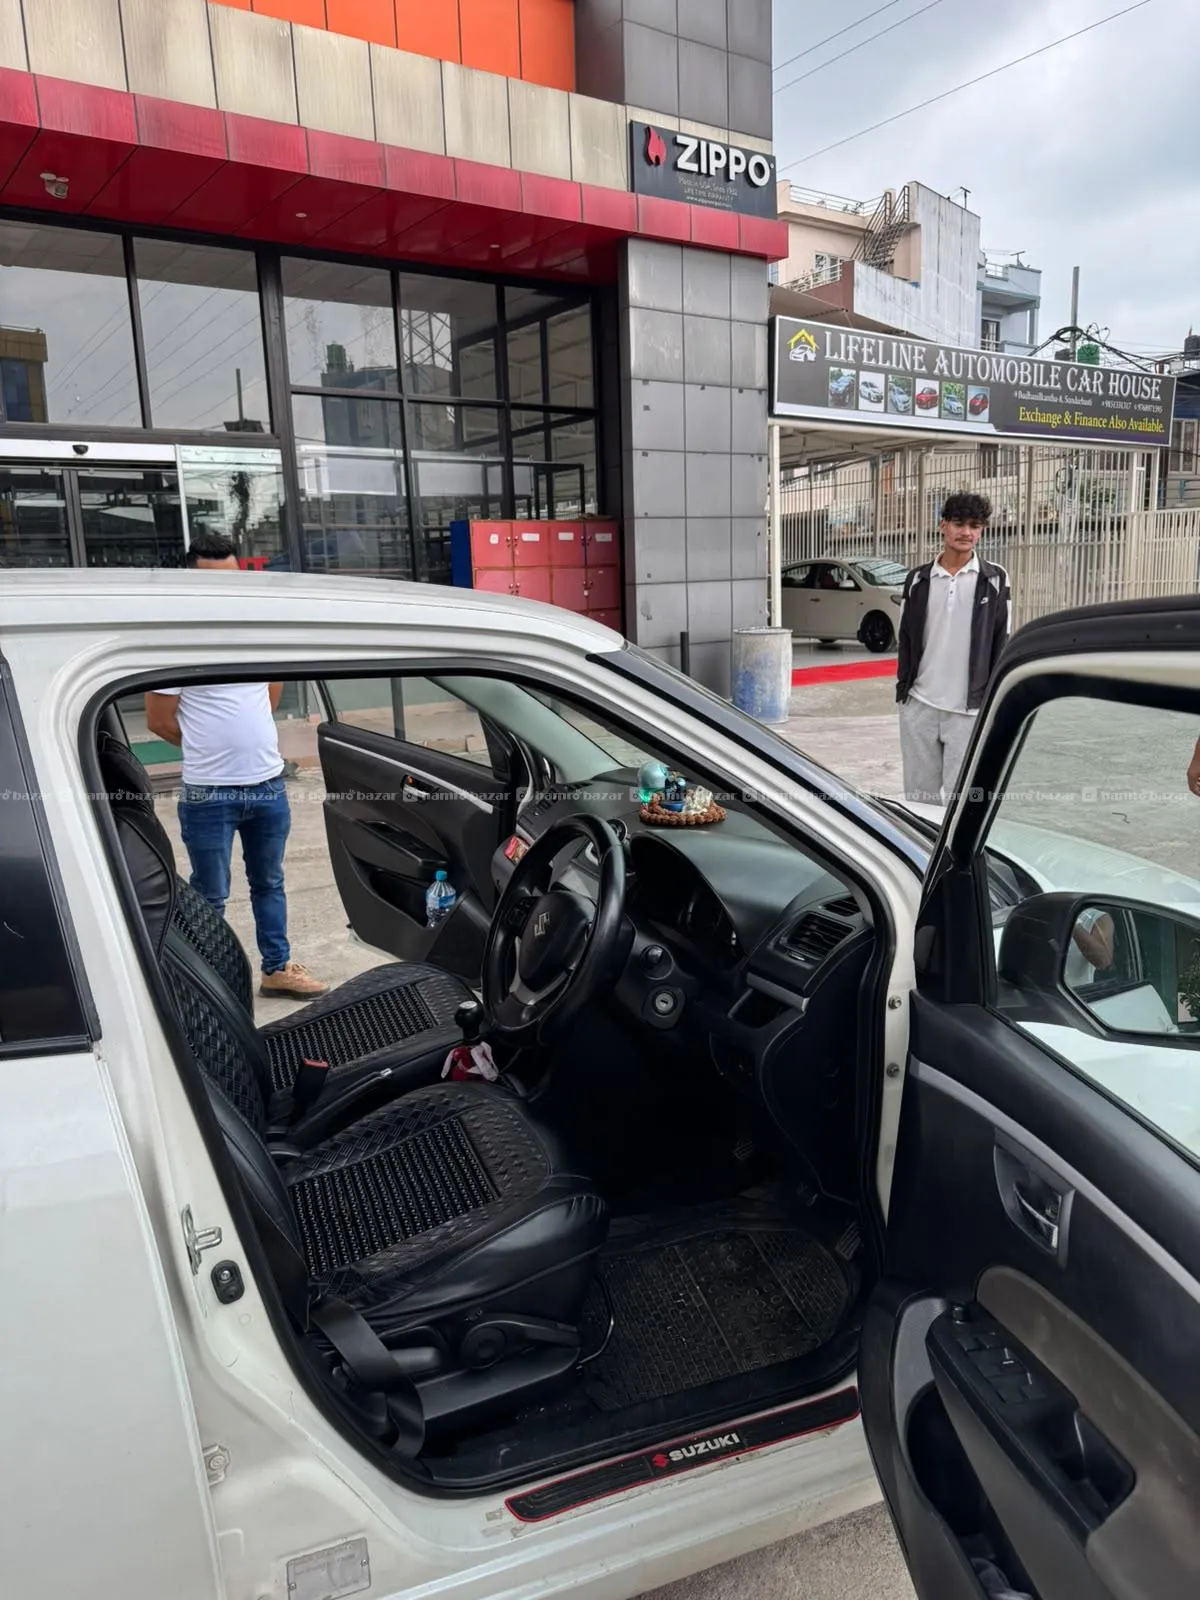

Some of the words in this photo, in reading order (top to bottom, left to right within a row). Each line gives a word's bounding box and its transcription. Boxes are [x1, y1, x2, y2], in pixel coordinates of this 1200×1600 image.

[675, 134, 771, 187] ZIPPO
[824, 331, 928, 374] LIFELINE
[932, 350, 1062, 390] AUTOMOBILE
[1066, 366, 1104, 396] CAR
[1108, 373, 1163, 400] HOUSE
[1019, 406, 1062, 429] Exchange
[1063, 410, 1072, 425] &
[1074, 411, 1108, 428] Finance
[1108, 414, 1128, 431] Also
[1128, 417, 1165, 433] Available.
[668, 1433, 740, 1462] SUZUKI
